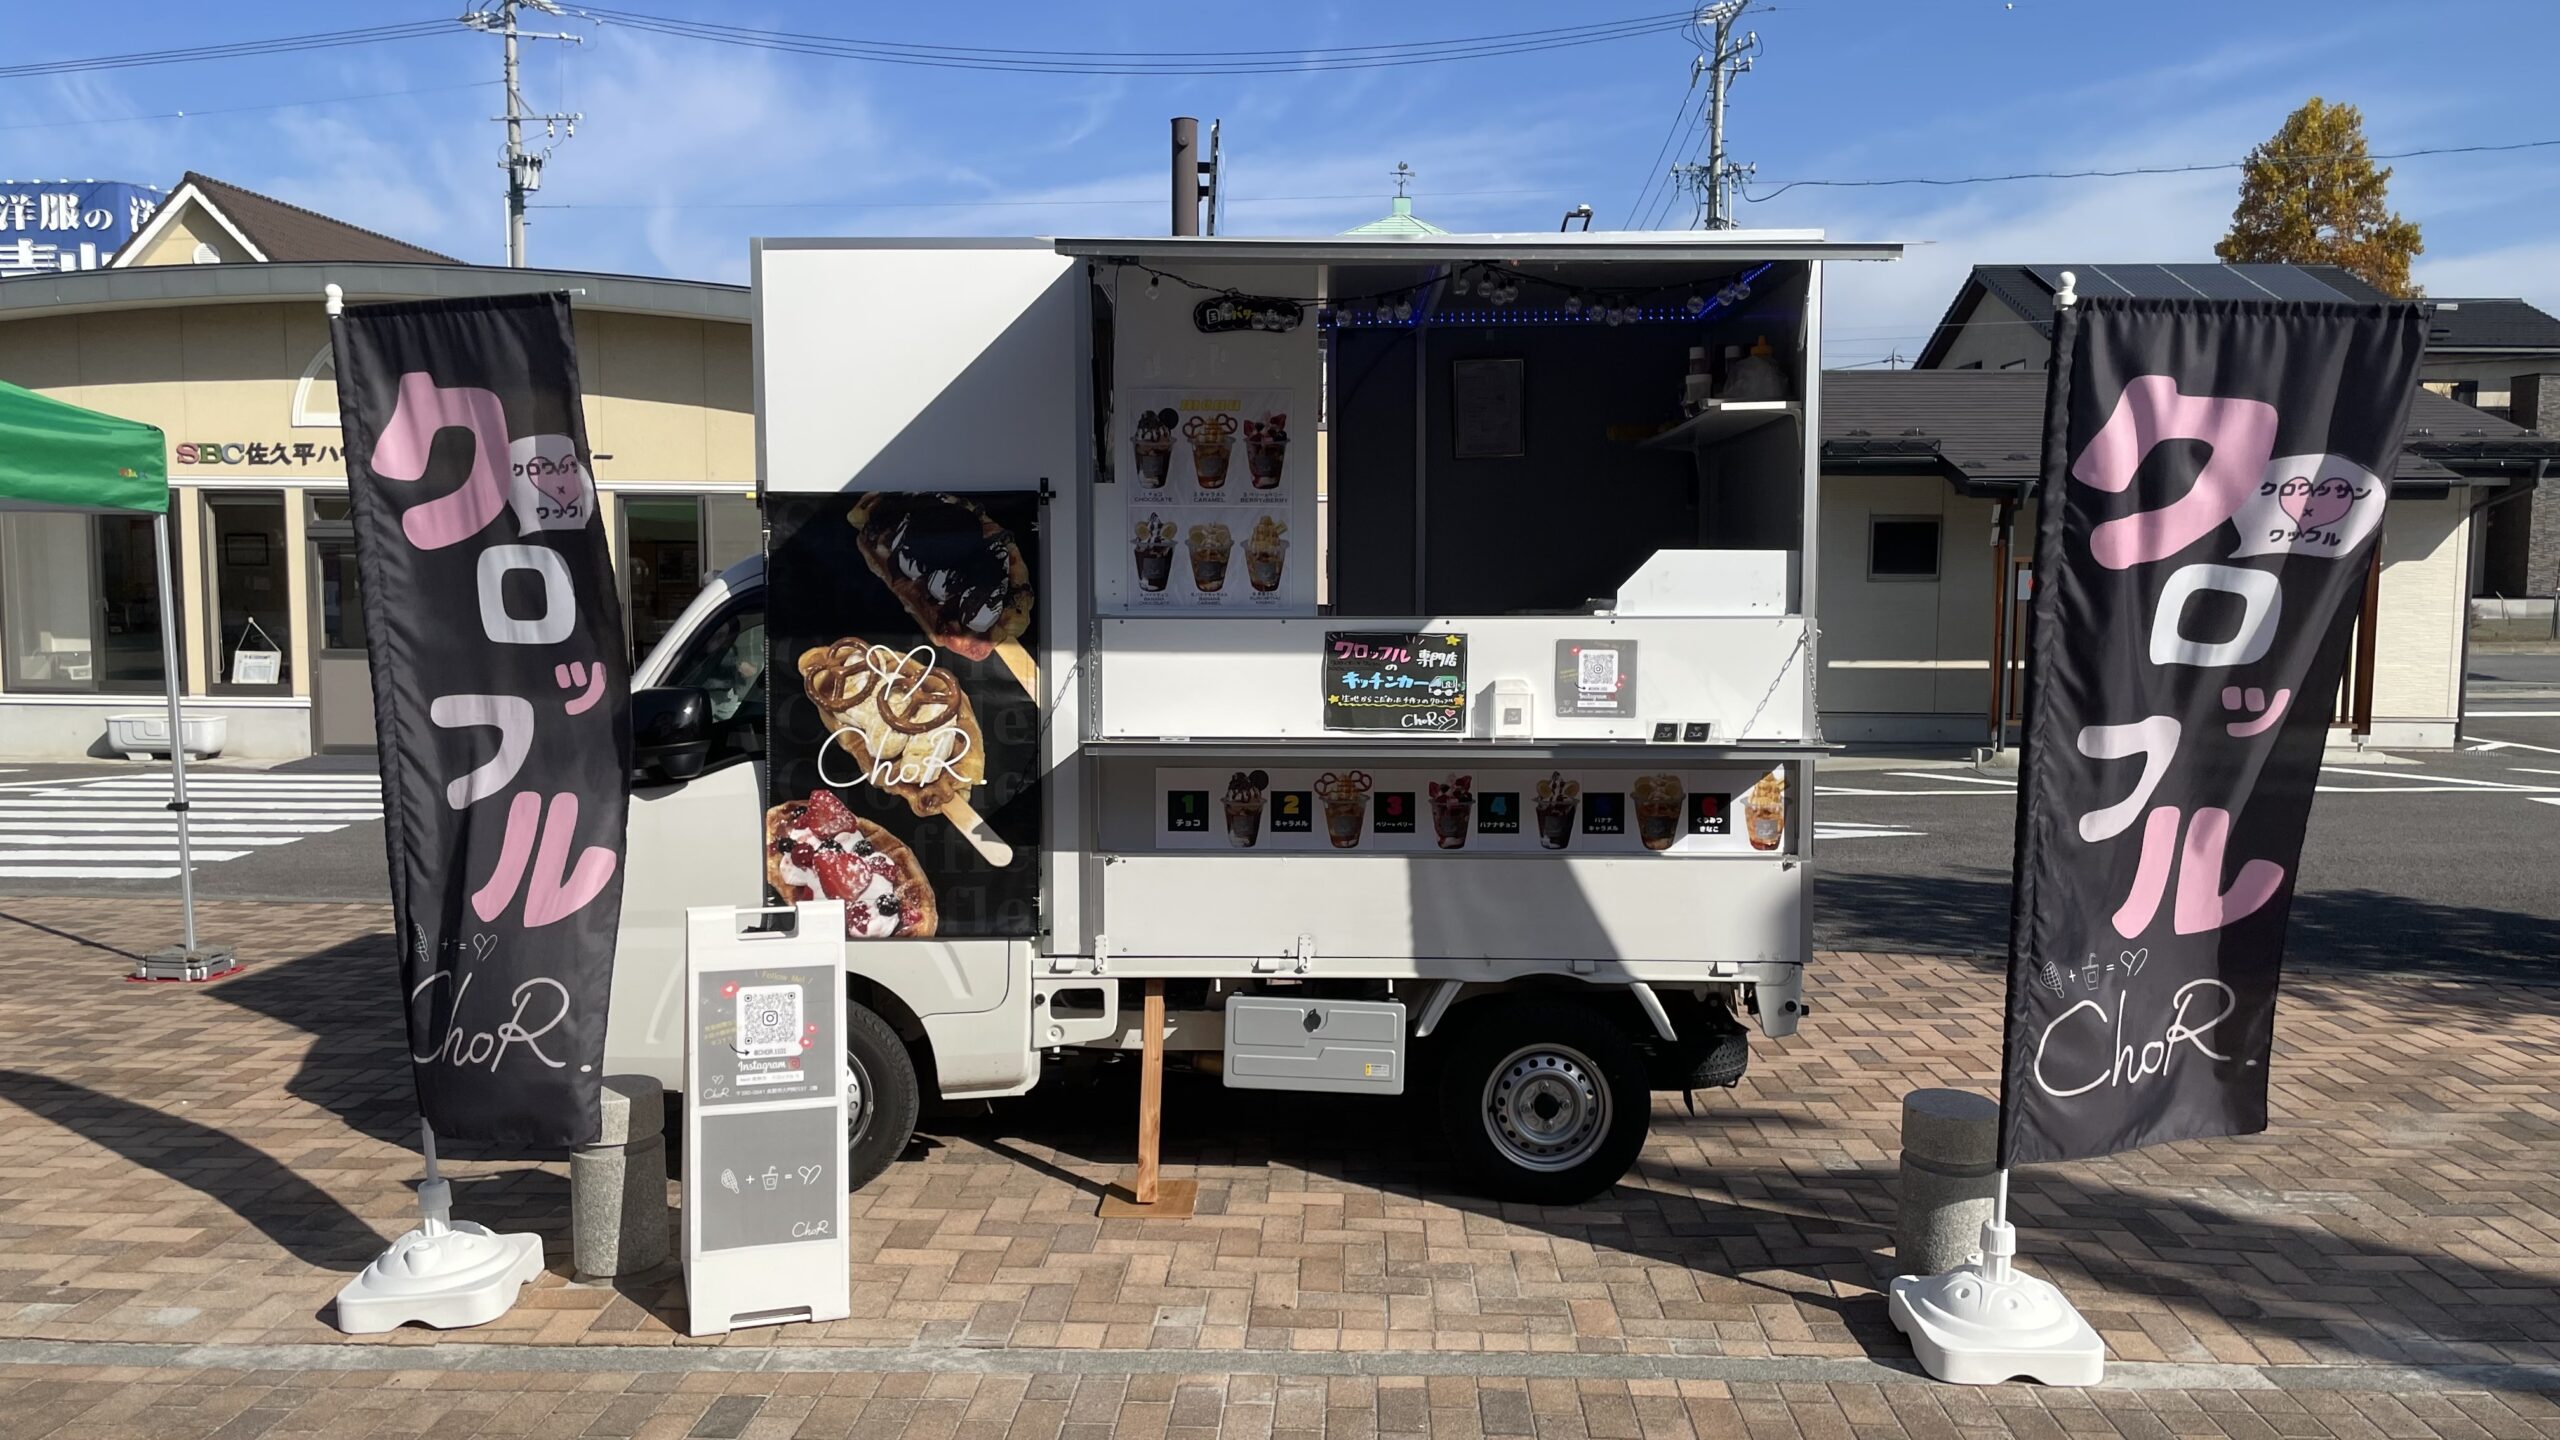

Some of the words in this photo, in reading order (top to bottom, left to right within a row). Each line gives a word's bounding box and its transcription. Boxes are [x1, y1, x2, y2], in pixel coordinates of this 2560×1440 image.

[2261, 481, 2372, 501] クロワッサン
[2269, 529, 2341, 546] ワッフル
[371, 372, 616, 928] クロッフル
[1334, 641, 1411, 664] クロッフル
[1416, 649, 1458, 668] 専門店
[2072, 374, 2291, 939] クロッフル
[1384, 663, 1398, 671] の
[1342, 671, 1430, 690] キッチンカー
[1181, 795, 1194, 814] 1
[1283, 795, 1300, 814] 2
[1386, 796, 1403, 816] 3
[1490, 796, 1507, 816] 4
[1176, 818, 1201, 827] チョコ
[738, 1060, 787, 1074] Instagram
